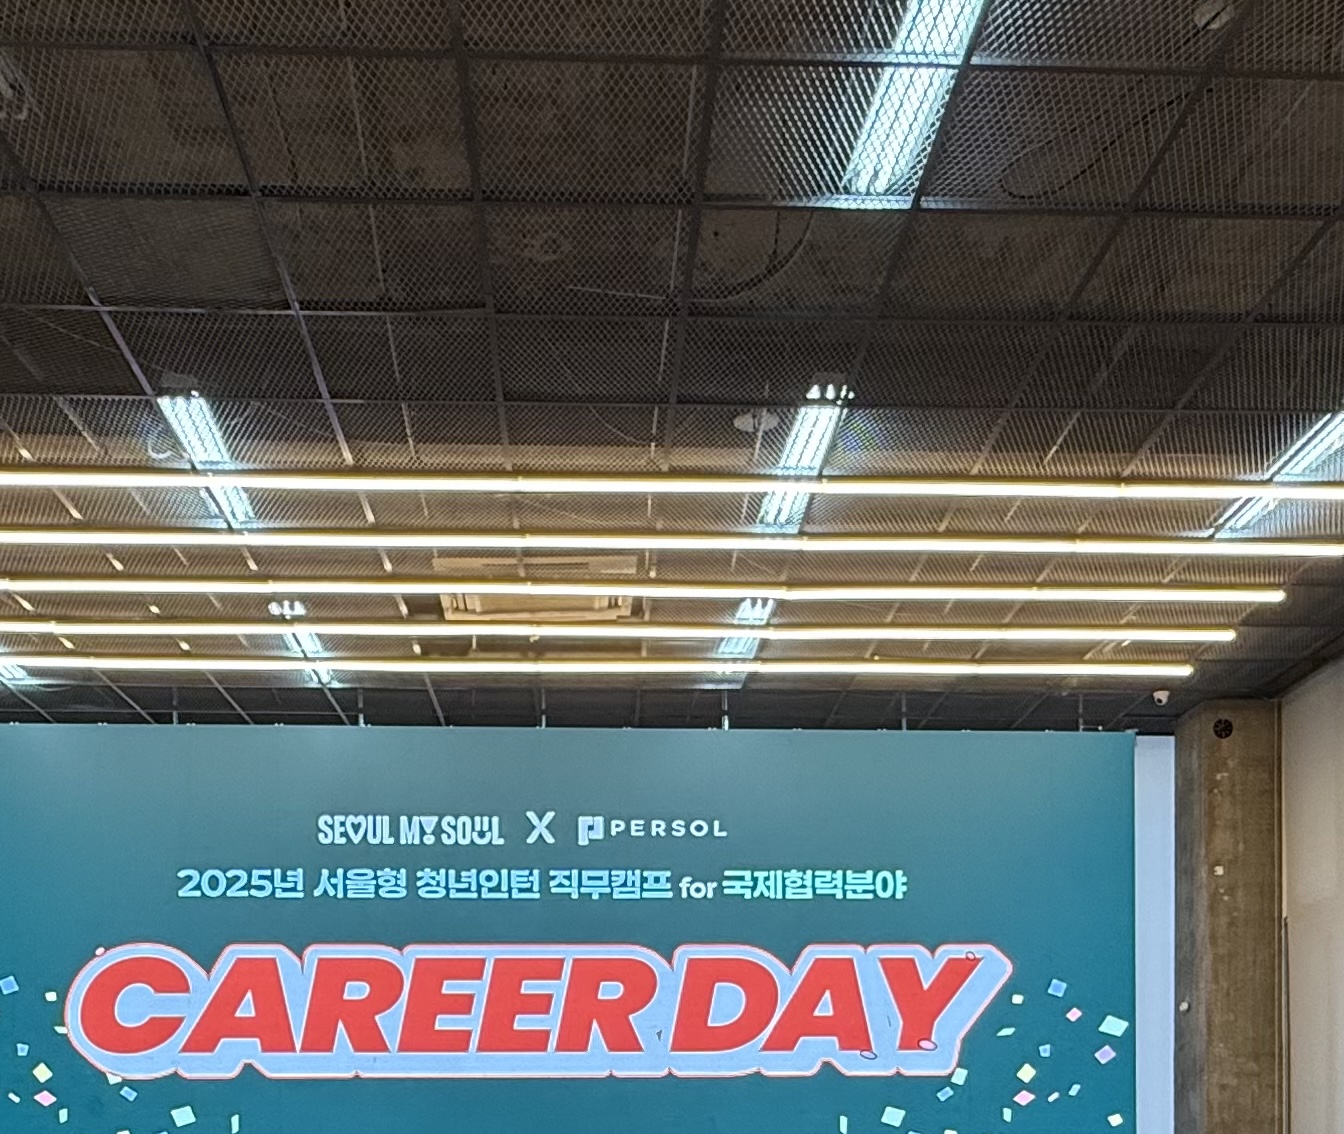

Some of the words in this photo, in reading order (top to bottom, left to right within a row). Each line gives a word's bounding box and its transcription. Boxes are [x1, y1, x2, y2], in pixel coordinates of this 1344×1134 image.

[317, 815, 395, 845] SEOUL
[440, 815, 505, 845] SOUL
[525, 810, 556, 844] X
[610, 819, 728, 837] PERSOL
[176, 867, 304, 898] 2025년
[312, 867, 408, 899] 서울형
[415, 867, 541, 899] 청년인턴
[548, 868, 673, 900] 직무캠프
[678, 876, 717, 898] for
[721, 869, 907, 900] 국제협력분야
[80, 956, 658, 1054] CAREER
[669, 956, 985, 1054] DAY
